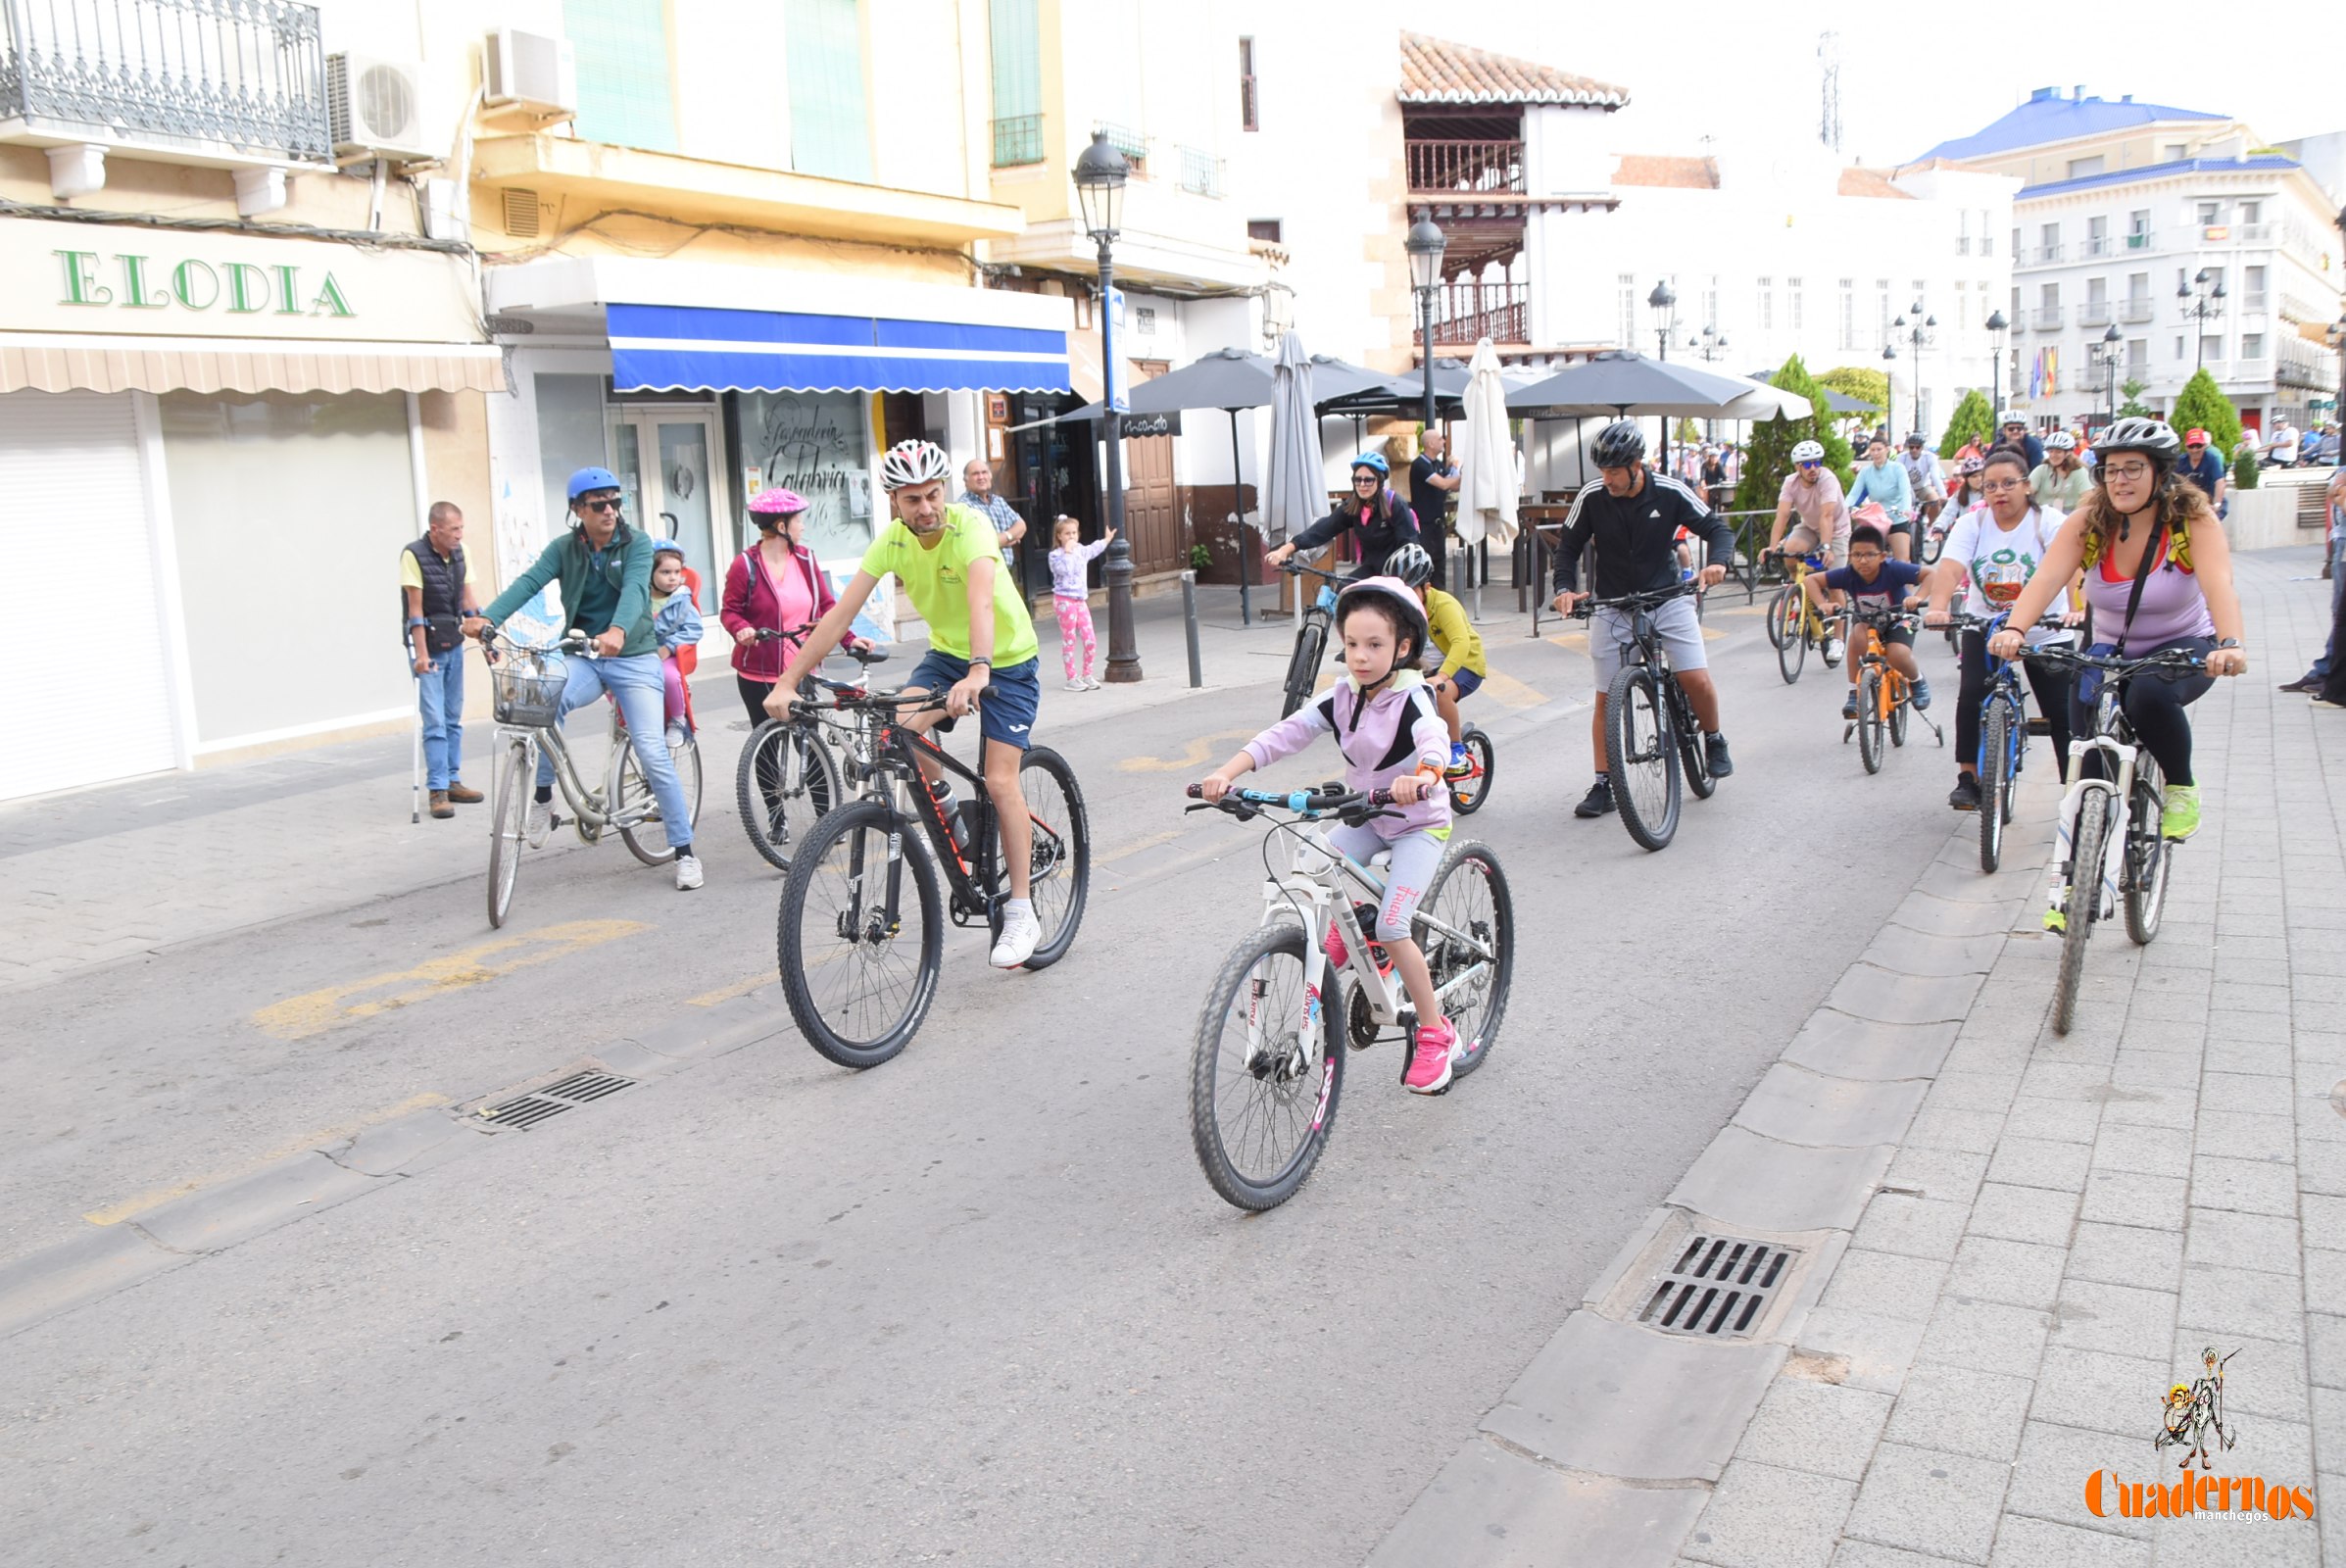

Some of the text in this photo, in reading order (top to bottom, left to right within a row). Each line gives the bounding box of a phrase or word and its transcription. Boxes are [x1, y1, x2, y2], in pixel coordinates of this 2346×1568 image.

[52, 249, 357, 318] ELODIA
[767, 441, 847, 495] Calabria
[1385, 885, 1420, 926] FRIEND
